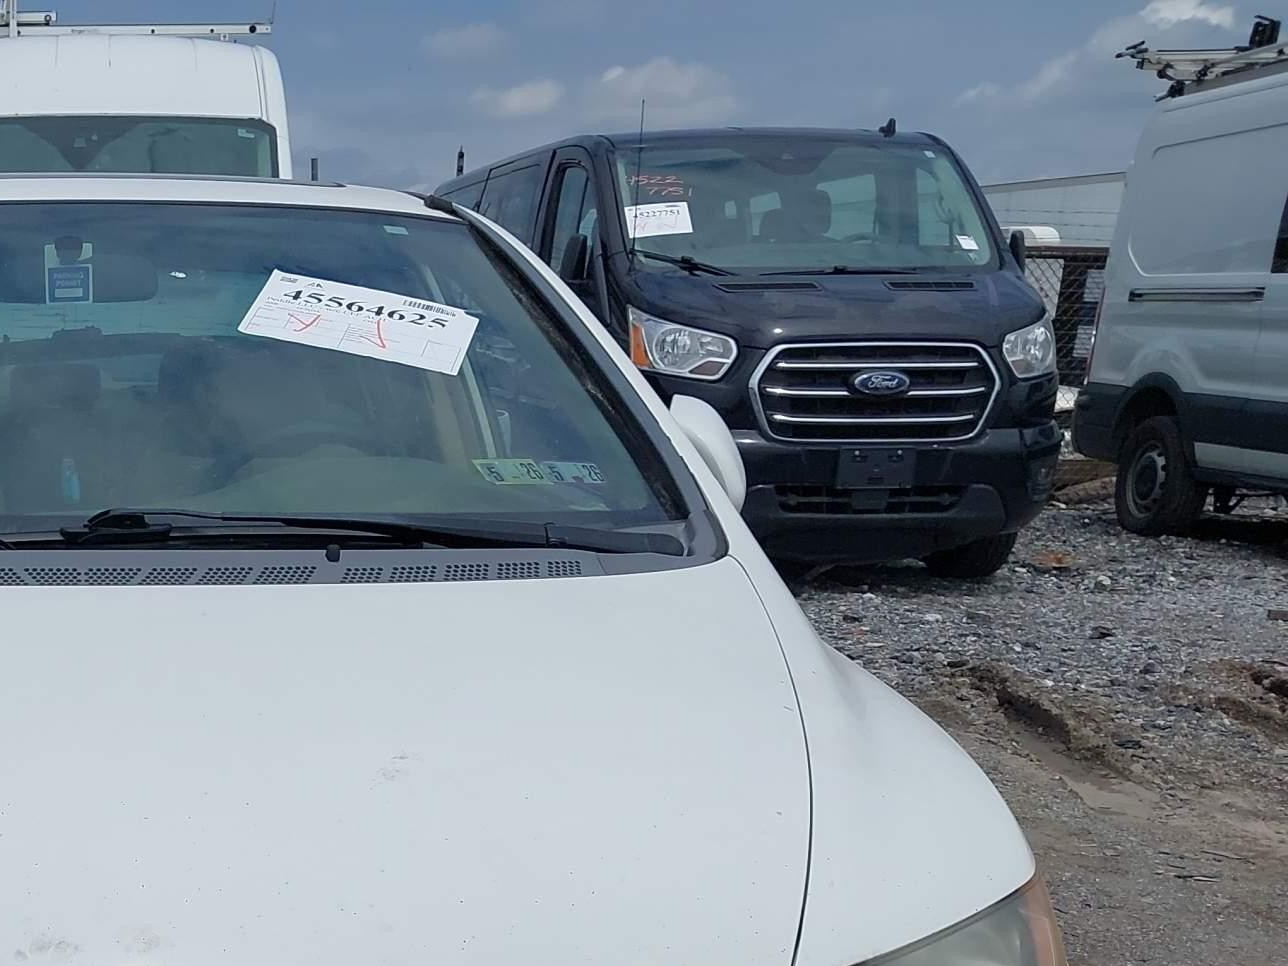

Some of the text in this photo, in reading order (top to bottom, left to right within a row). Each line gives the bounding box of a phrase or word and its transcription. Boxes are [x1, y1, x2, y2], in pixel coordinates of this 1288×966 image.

[282, 288, 450, 329] 45564625
[868, 375, 899, 388] Ford
[486, 462, 544, 482] 5 26
[548, 463, 605, 482] 5 26
